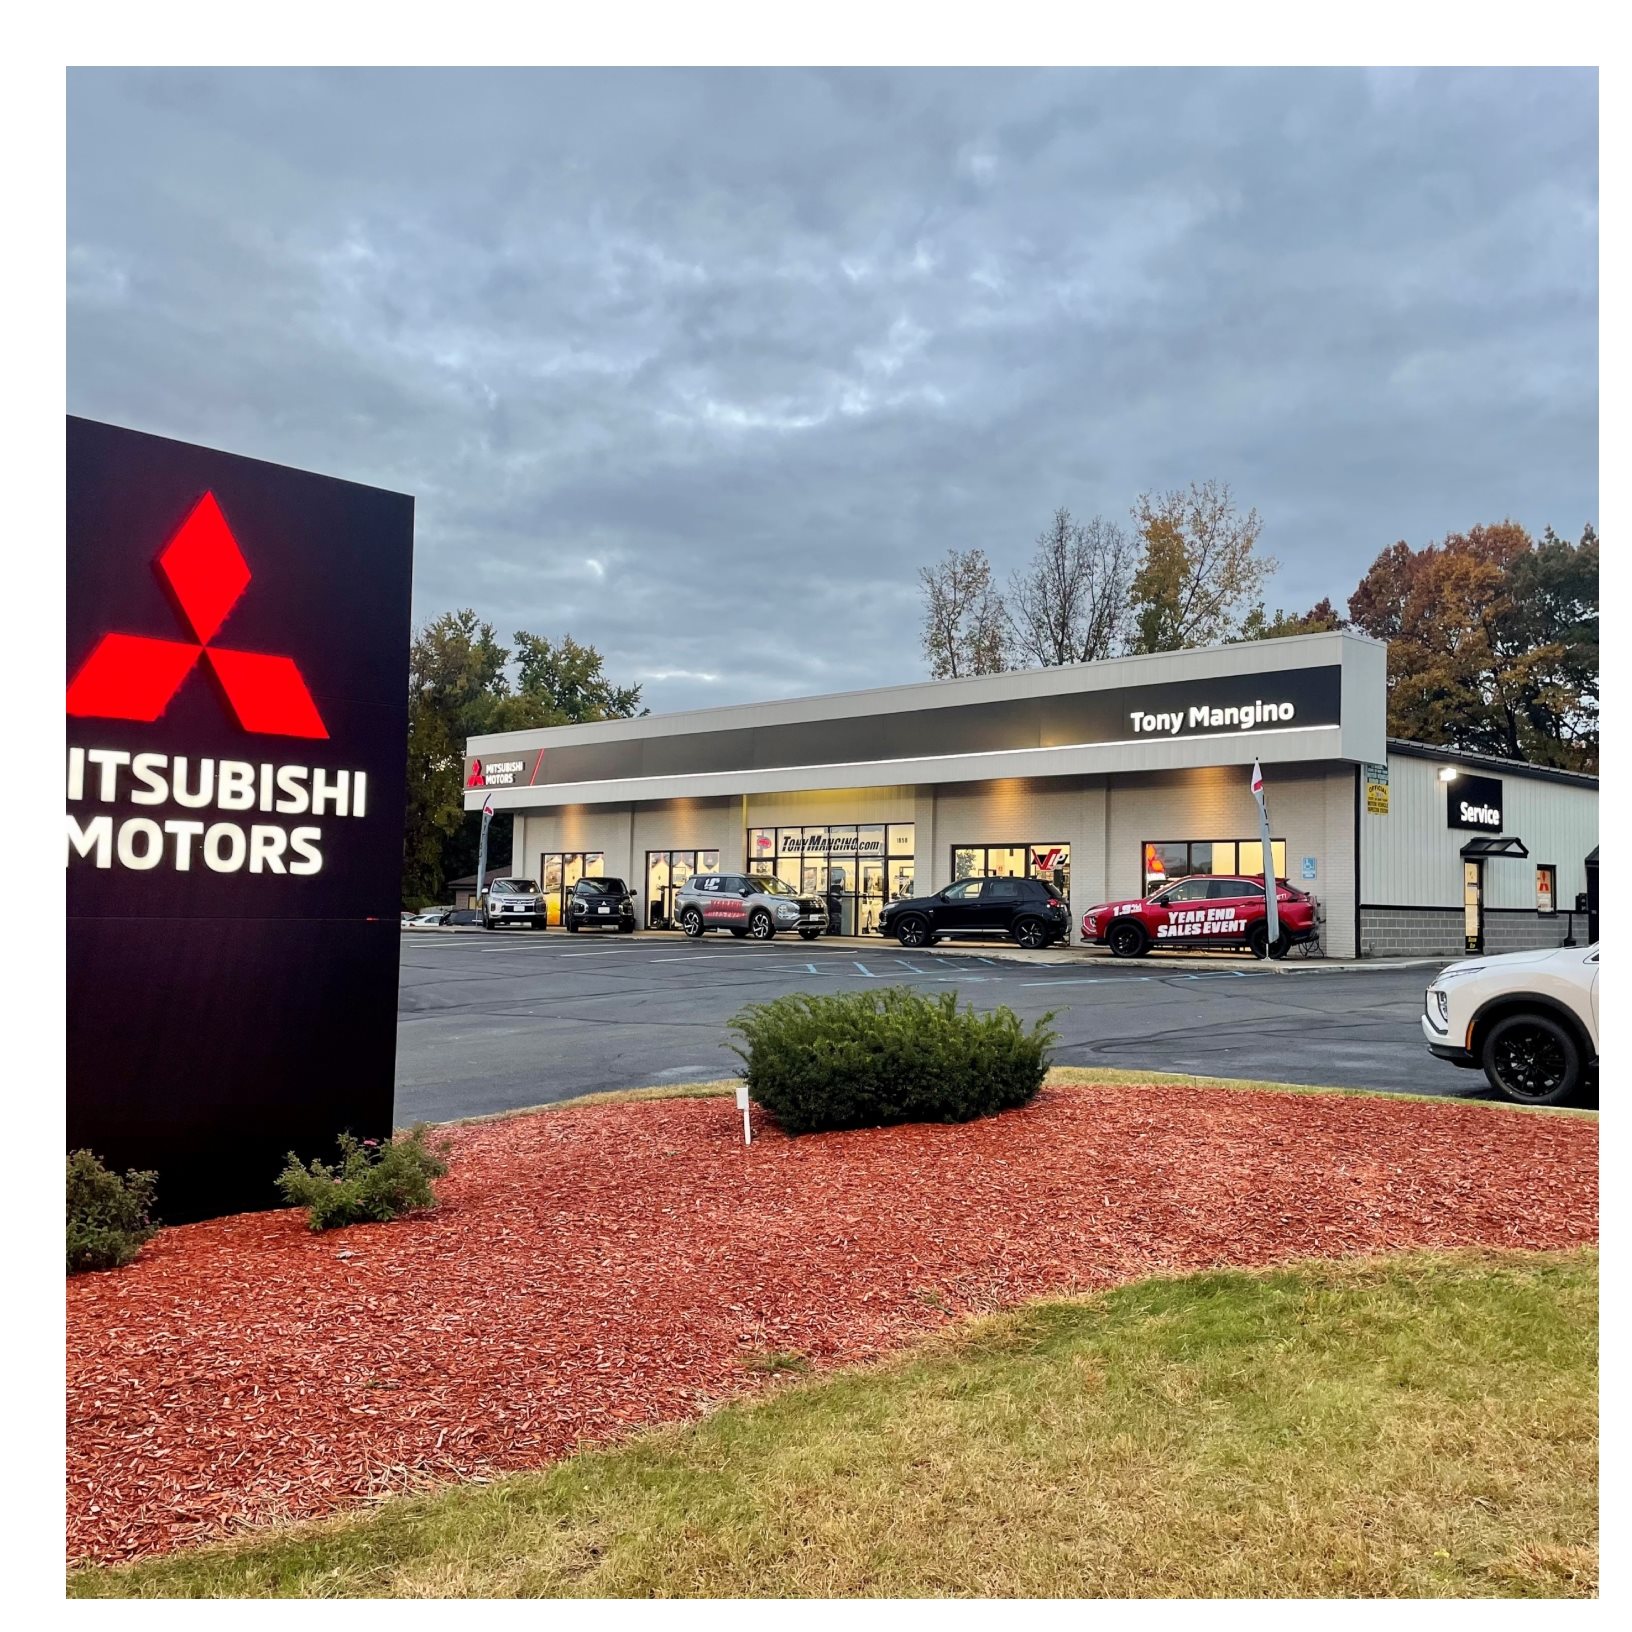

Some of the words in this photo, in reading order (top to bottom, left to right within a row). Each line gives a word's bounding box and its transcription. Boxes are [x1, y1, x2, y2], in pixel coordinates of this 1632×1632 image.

[1130, 711, 1184, 735] Tony
[1189, 700, 1295, 730] Mangino
[486, 761, 523, 774] MITSUBISHI
[67, 747, 366, 817] ITSUBISHI
[486, 774, 514, 785] MOTORS
[1460, 801, 1500, 825] Service
[66, 814, 323, 876] MOTORS
[1031, 849, 1068, 870] VIP
[1168, 911, 1205, 924] YEAR
[1207, 908, 1236, 921] END
[1157, 922, 1202, 938] SALES
[1203, 919, 1248, 934] EVENT
